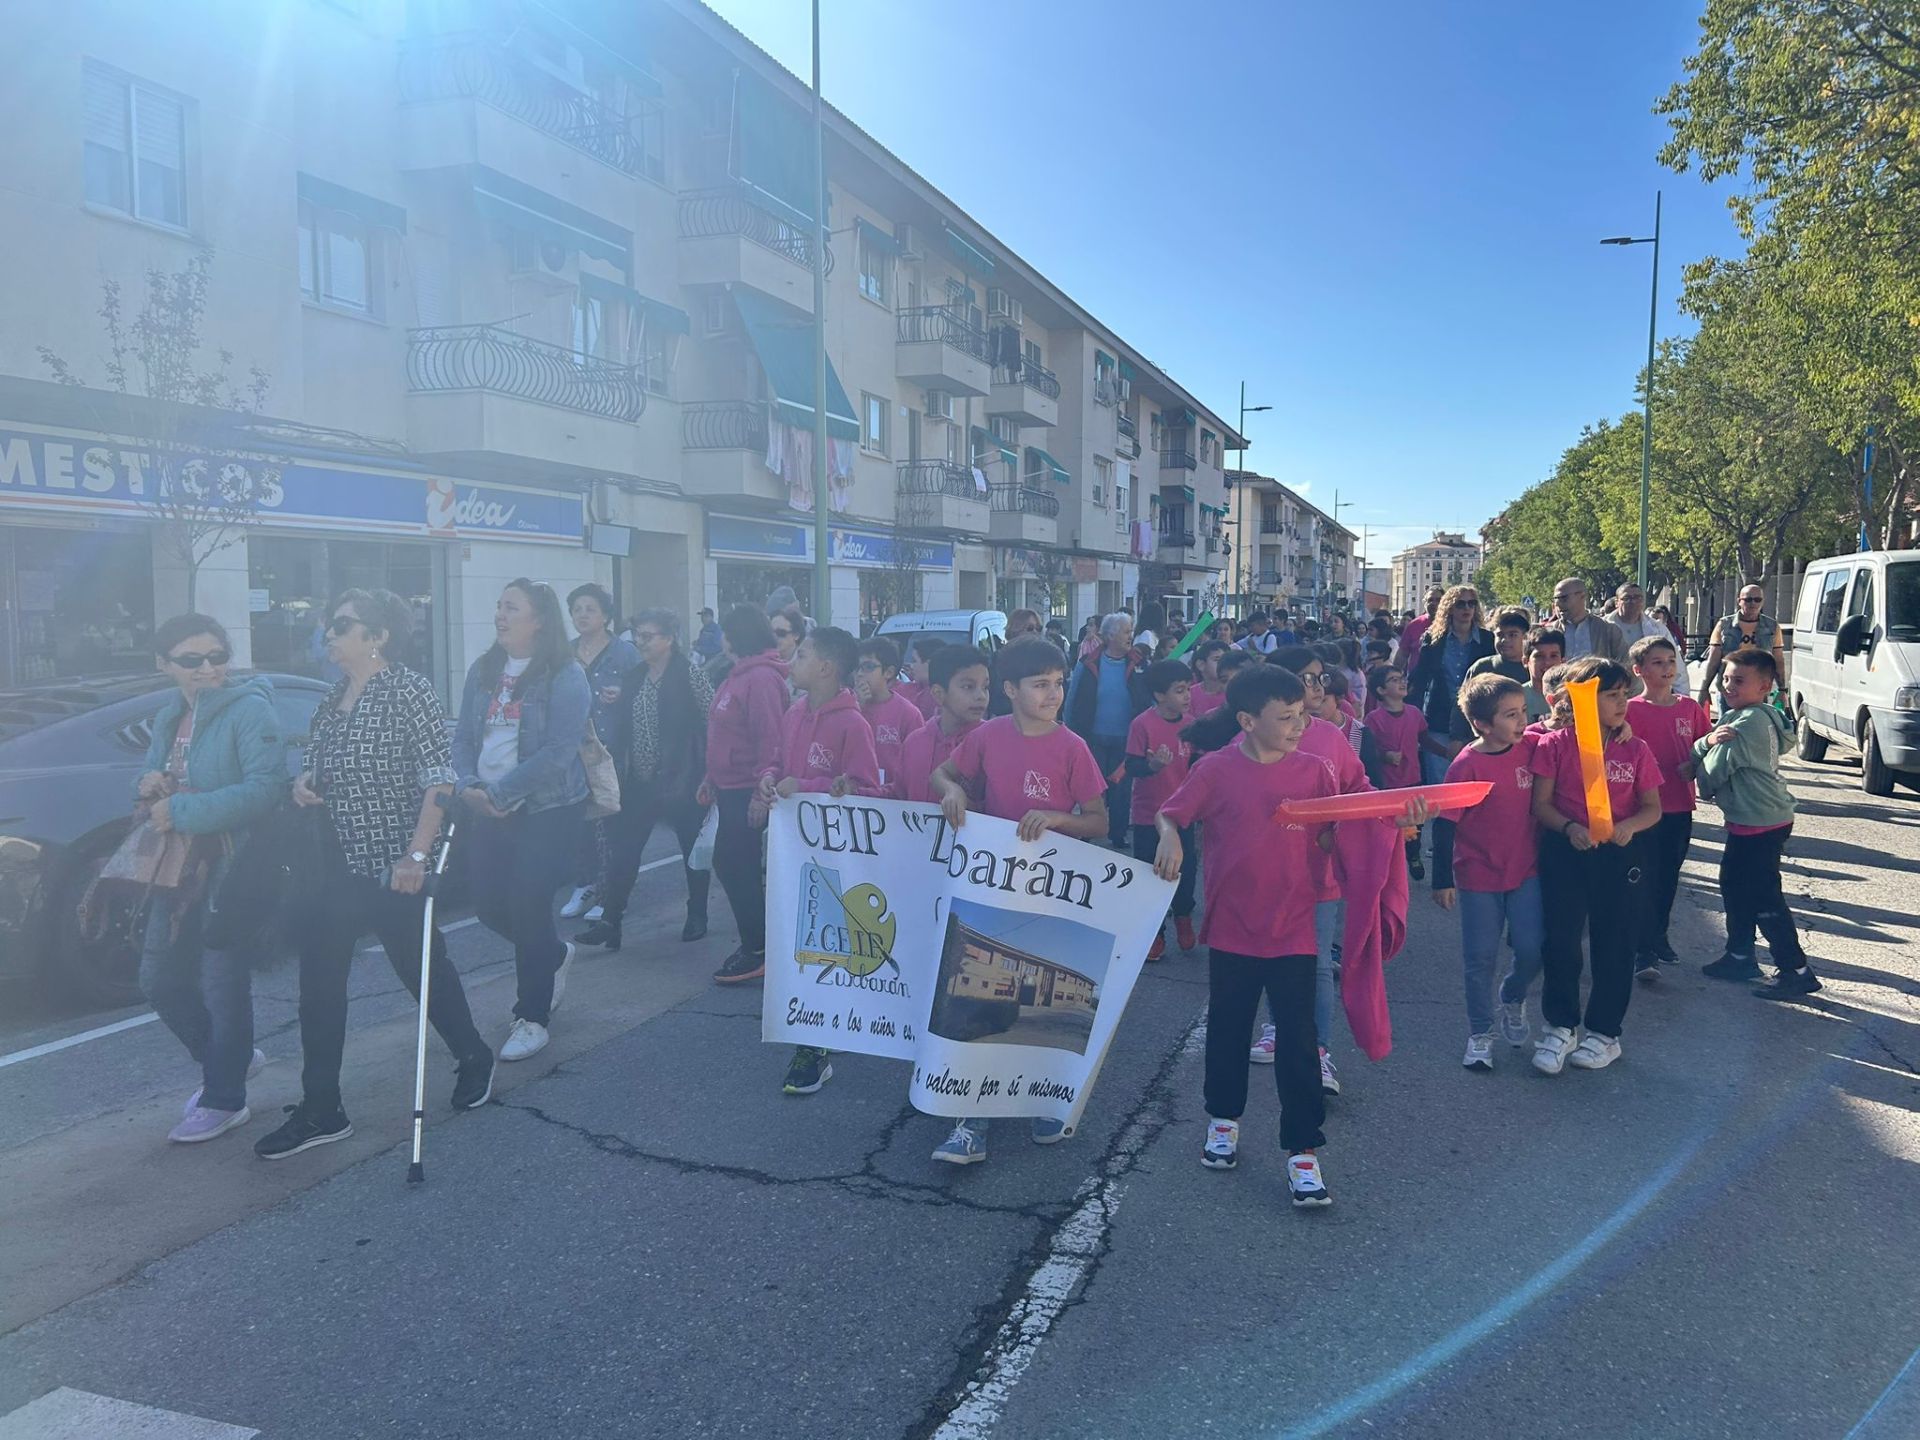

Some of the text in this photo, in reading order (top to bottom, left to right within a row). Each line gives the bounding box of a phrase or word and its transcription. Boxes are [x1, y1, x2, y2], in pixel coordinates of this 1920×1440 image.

[426, 477, 516, 529] idea
[796, 800, 886, 856] CEIP
[804, 868, 820, 947] CORIA
[786, 996, 825, 1026] Educar
[832, 1011, 839, 1029] a
[847, 1007, 862, 1033] los
[870, 1014, 896, 1038] niños
[925, 1067, 971, 1097] valerse
[977, 1074, 1000, 1104] por
[1007, 1074, 1023, 1097] sí
[1028, 1077, 1075, 1103] mismos
